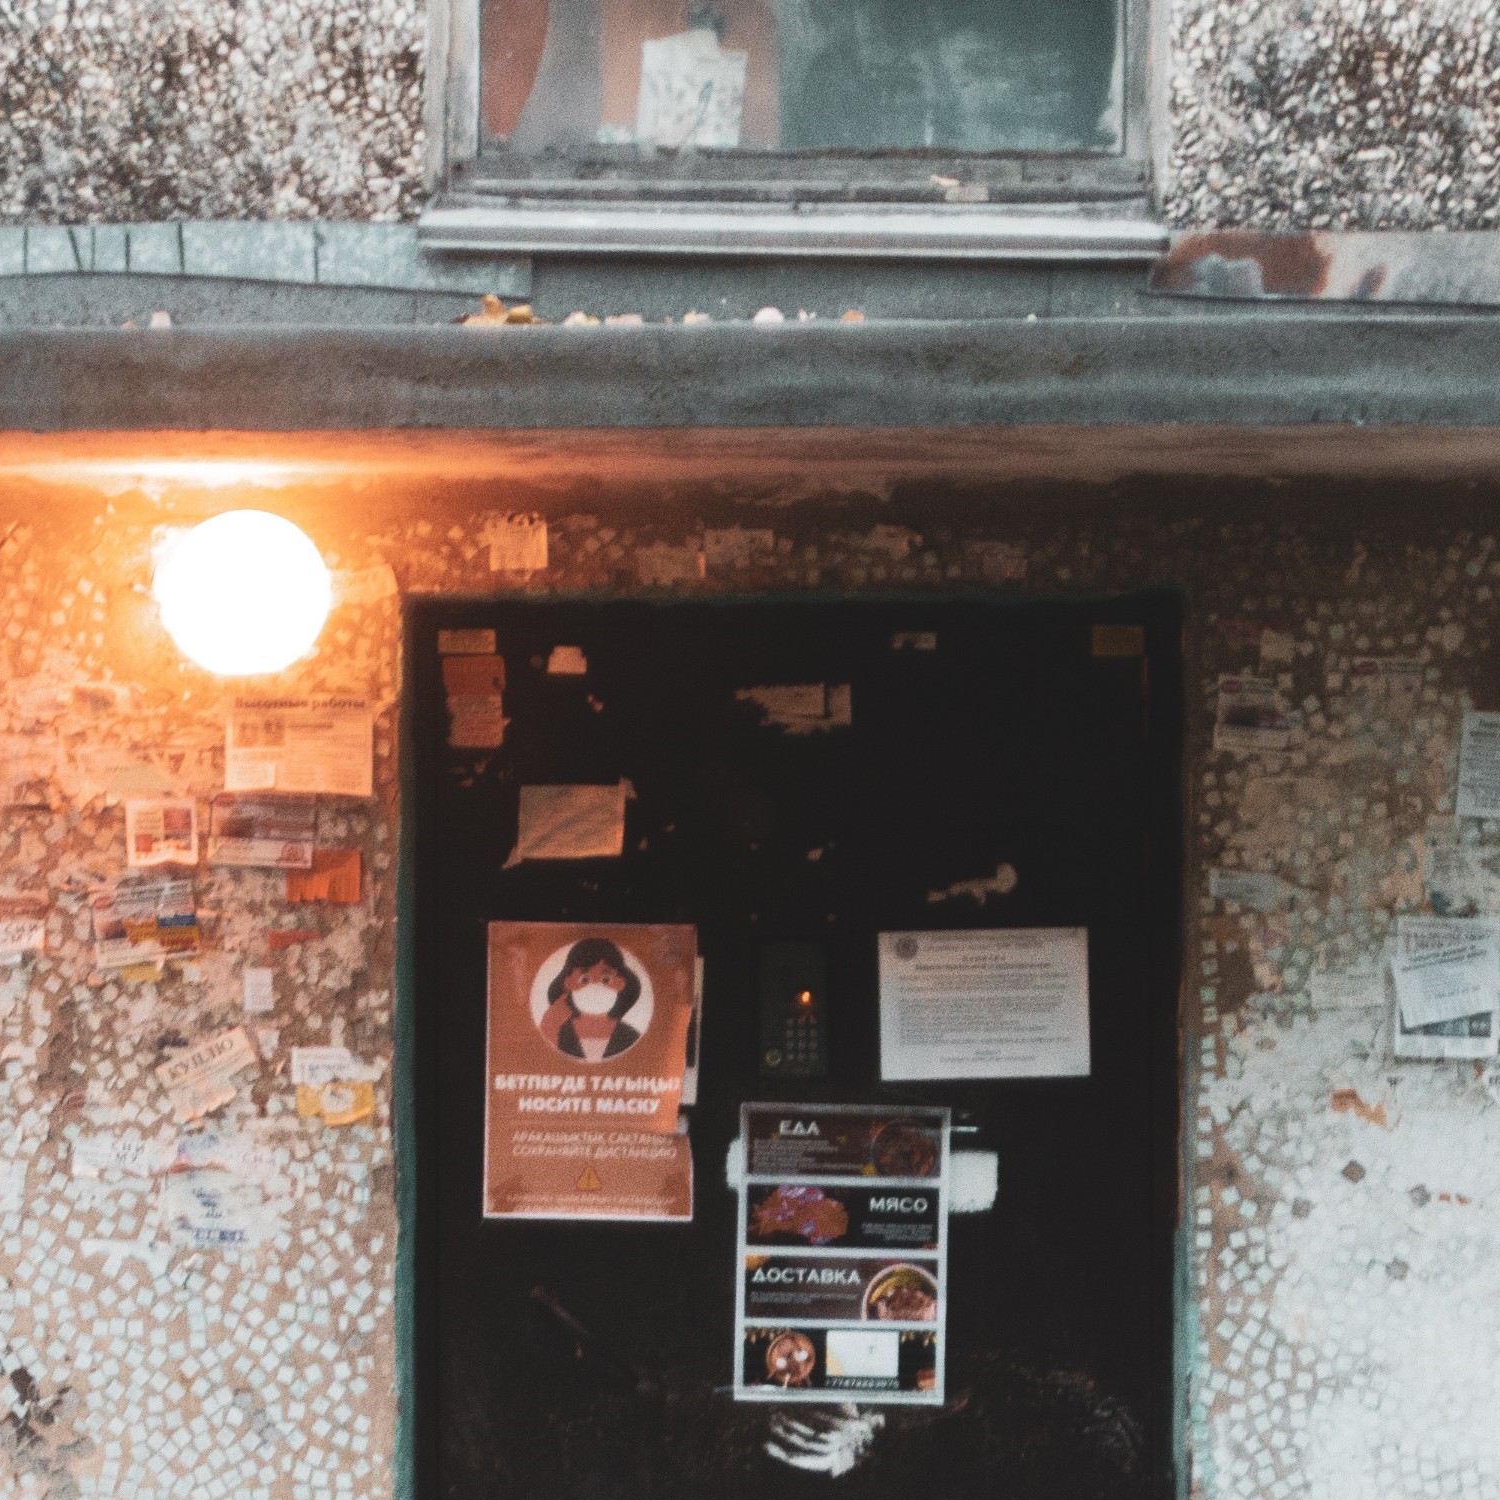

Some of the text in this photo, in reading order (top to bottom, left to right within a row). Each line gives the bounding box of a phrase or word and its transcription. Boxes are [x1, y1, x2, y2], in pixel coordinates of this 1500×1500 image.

[168, 1038, 234, 1081] КУПЛЮ
[495, 1074, 587, 1094] БЕТПЕРДЕ
[518, 1097, 661, 1114] НОСИТЕ МАСКУ
[869, 1196, 928, 1213] МЯСО
[752, 1267, 862, 1285] ДОСТАВКА
